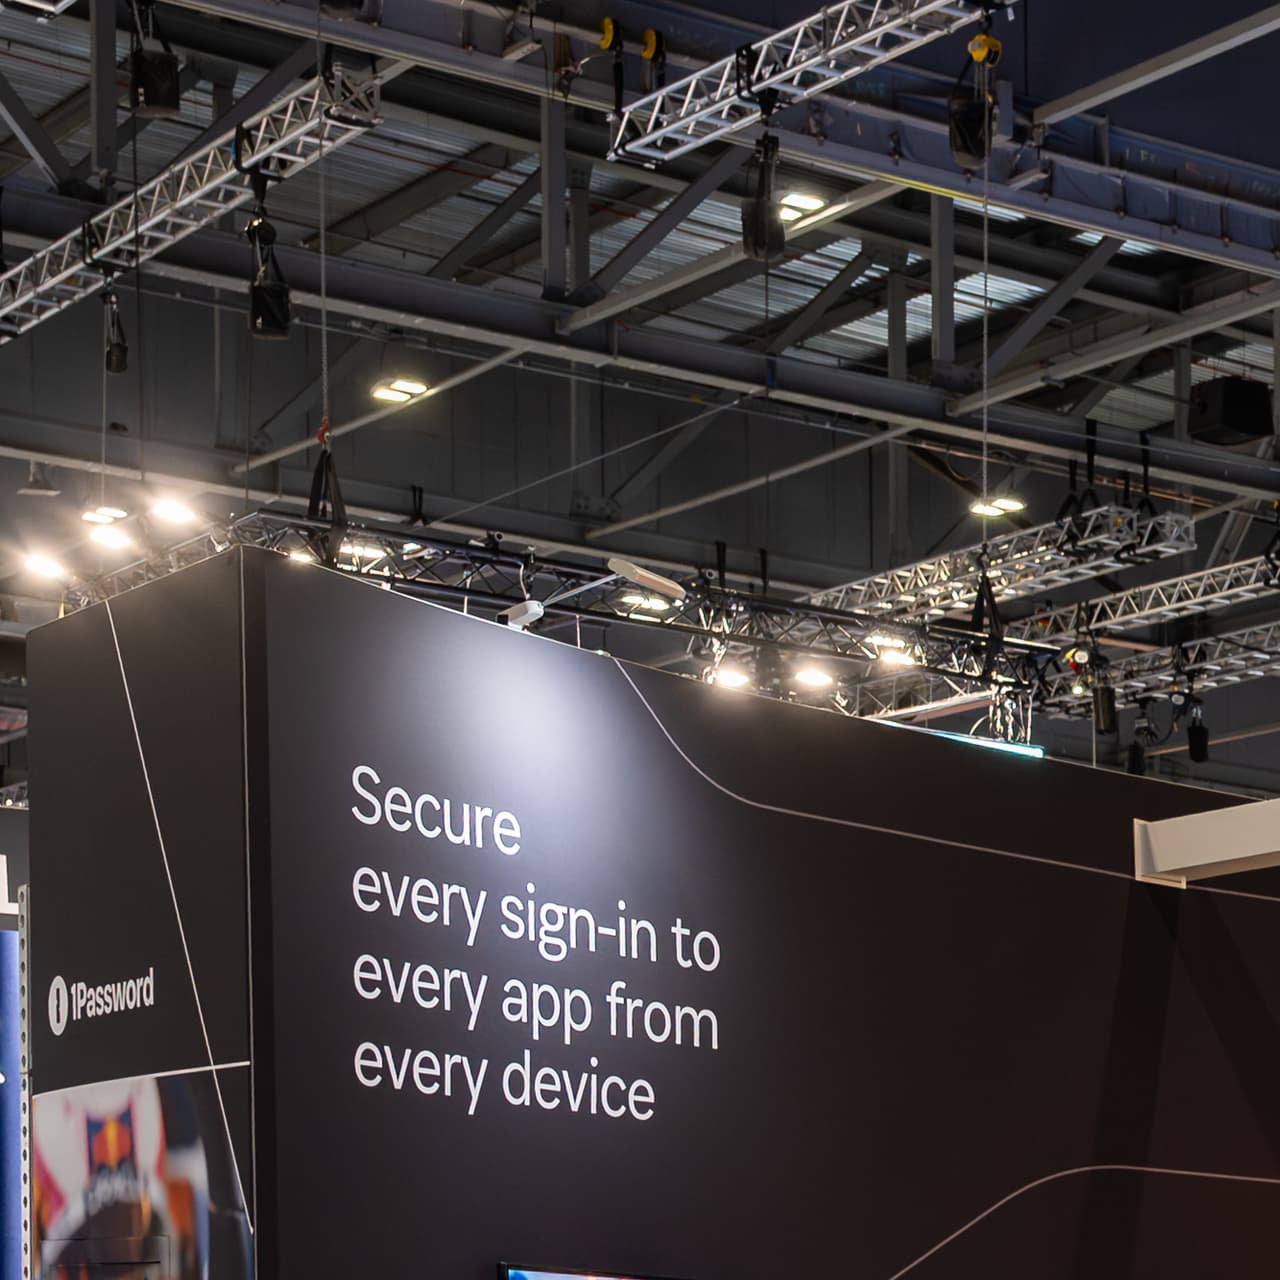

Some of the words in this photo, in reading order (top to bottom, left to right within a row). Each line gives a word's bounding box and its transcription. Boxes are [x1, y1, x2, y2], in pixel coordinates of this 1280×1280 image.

[351, 765, 522, 856] Secure
[352, 867, 487, 947] every
[500, 882, 657, 962] sign-in
[671, 917, 721, 972] to
[70, 967, 154, 1022] 1Password
[353, 953, 488, 1032] every
[502, 977, 593, 1045] app
[605, 981, 719, 1050] from
[354, 1041, 488, 1116] every
[502, 1048, 656, 1122] device
